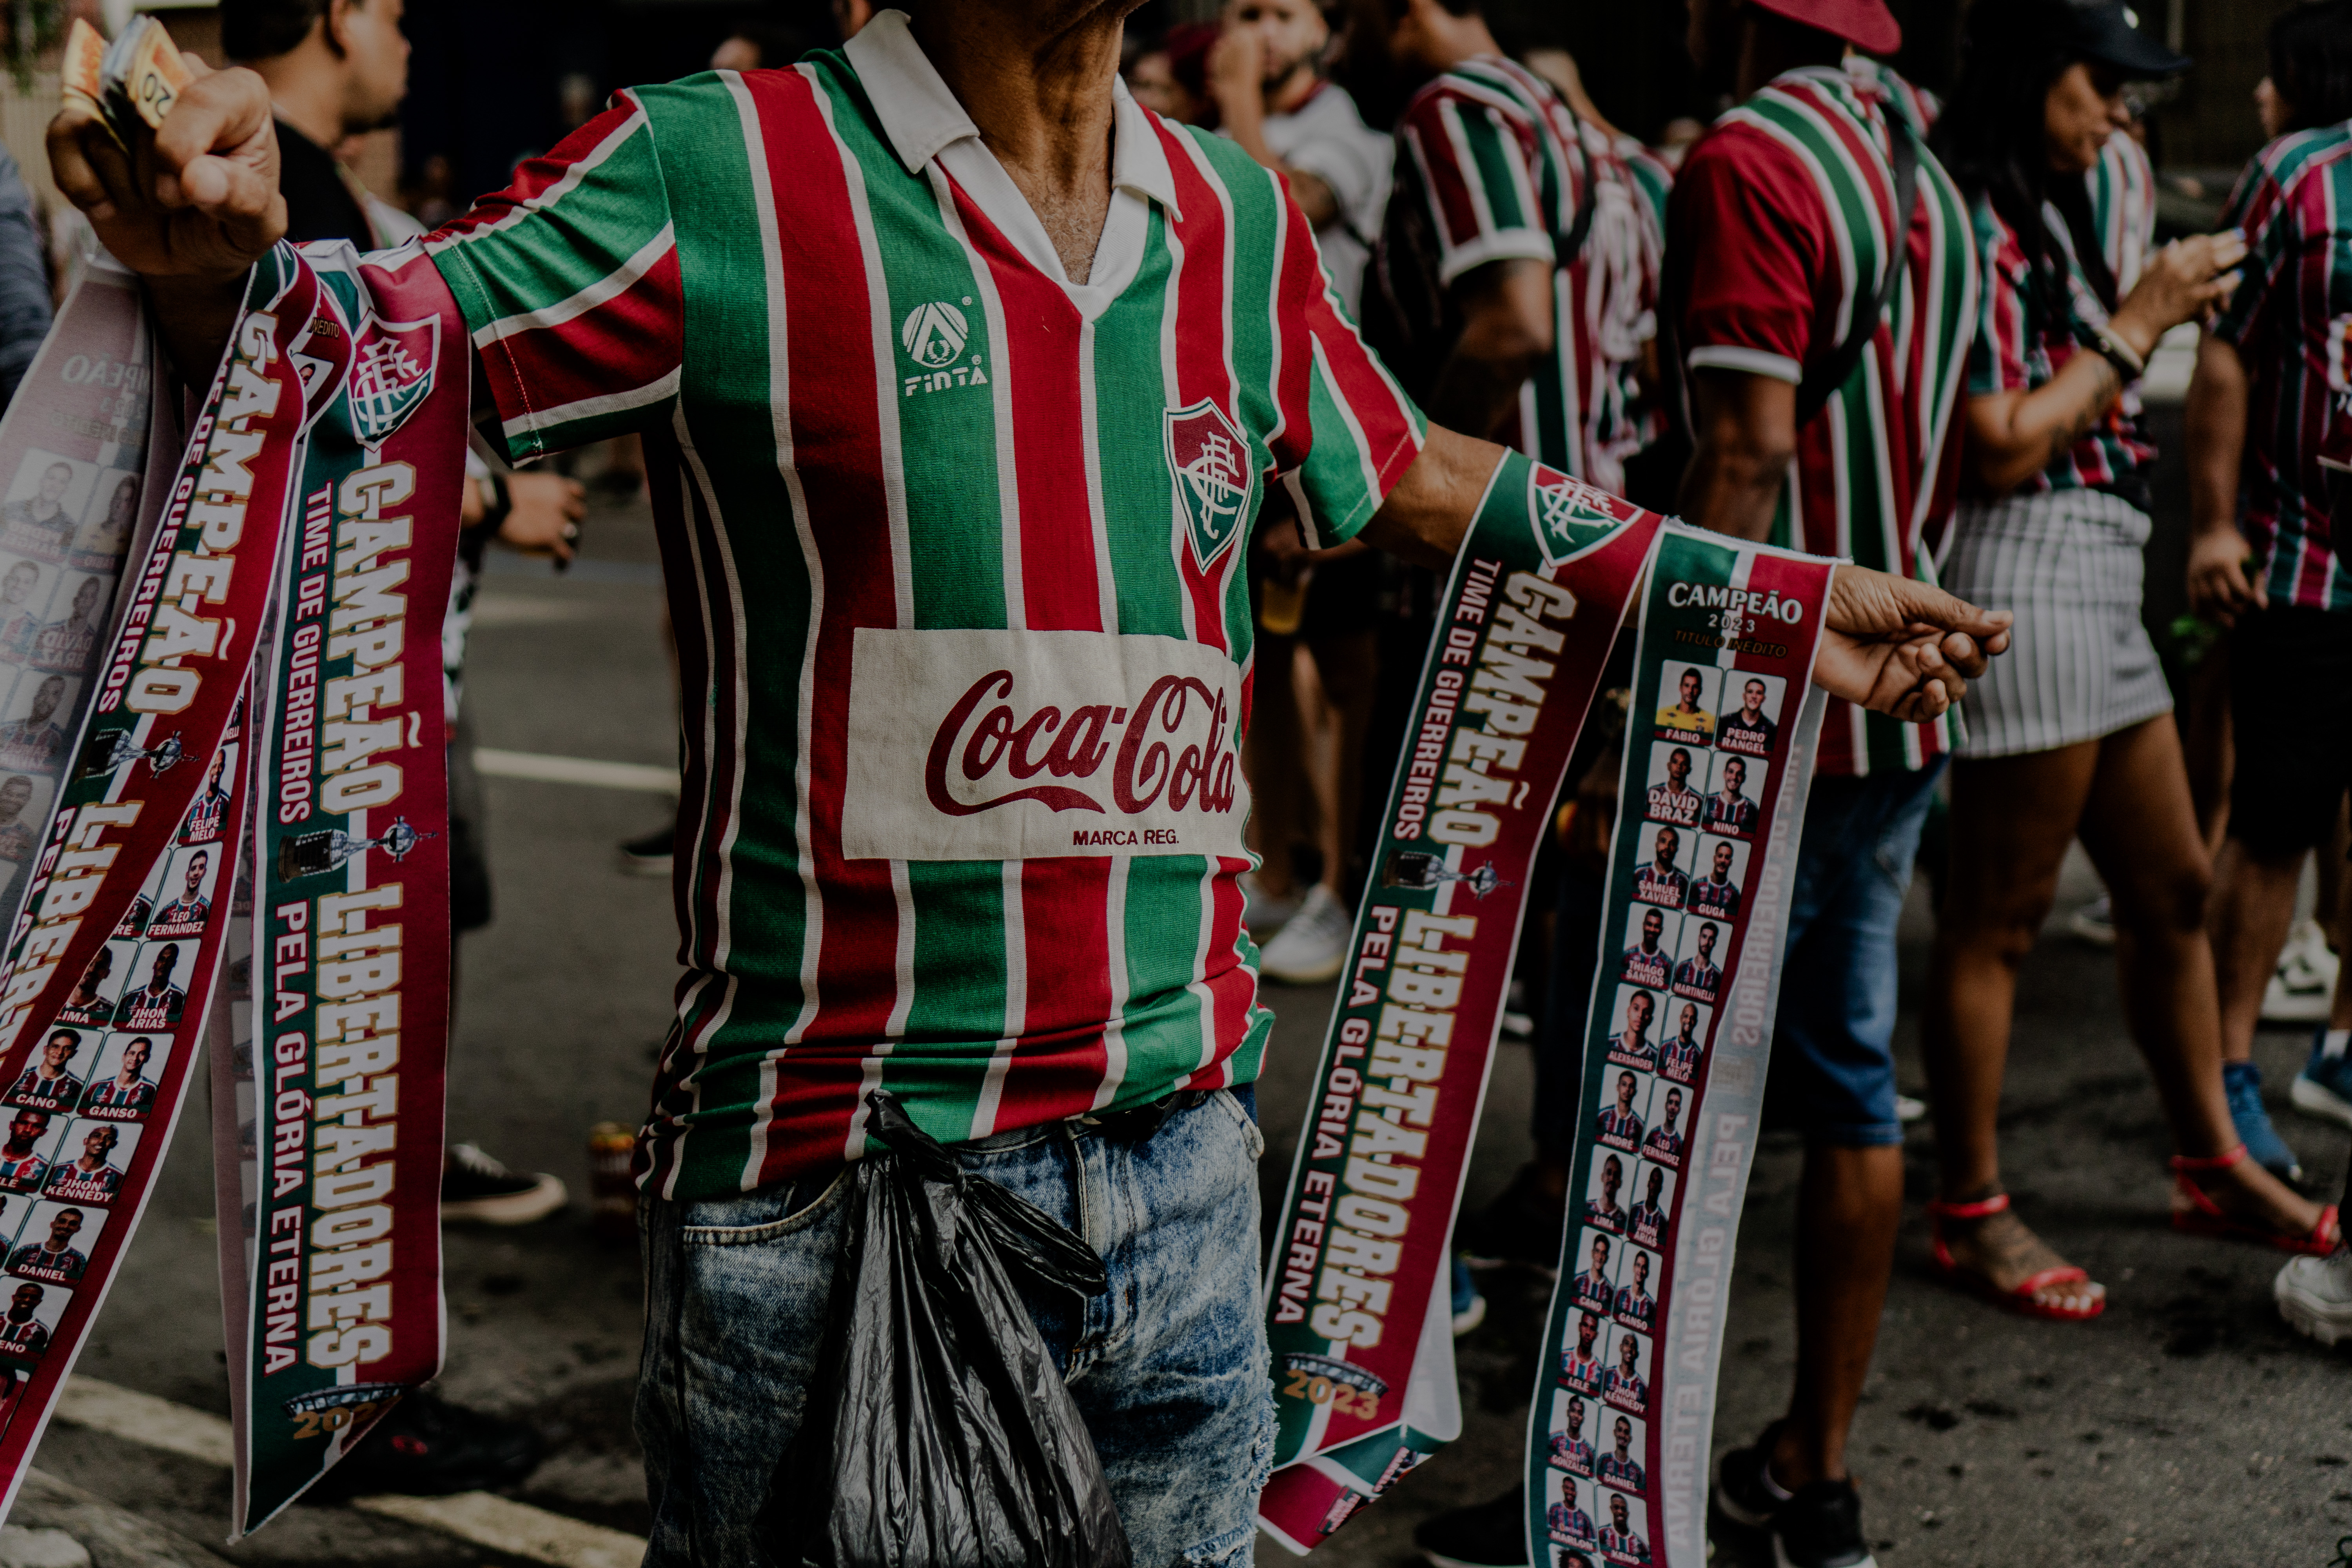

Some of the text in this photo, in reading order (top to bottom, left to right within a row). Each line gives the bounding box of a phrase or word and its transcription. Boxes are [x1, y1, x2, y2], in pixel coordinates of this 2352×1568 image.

[125, 309, 282, 714] CAMPEÃO
[98, 474, 195, 715] GUERREIROS
[1667, 581, 1803, 625] CAMPEÃO
[1708, 613, 1755, 633] 2023
[319, 460, 423, 815] CAMPEÃO
[1674, 628, 1788, 659] TÍTULO INÉDITO
[277, 478, 333, 825] TIME DE GUERREIROS
[1393, 556, 1503, 841] TIME DE GUERREIROS
[1426, 570, 1579, 848] CAMPEÃO
[926, 670, 1235, 816] Coca-Cola
[1726, 728, 1766, 742] PEDRO
[1721, 737, 1765, 754] RANGEL
[1648, 789, 1699, 811] DAVID
[189, 815, 220, 831] FELIPE
[1649, 803, 1695, 825] BRAZ
[189, 828, 215, 842] MELO
[1713, 821, 1739, 835] NINO
[1073, 829, 1180, 846] MARCA REG.
[1638, 880, 1681, 899] SAMUEL
[1639, 889, 1678, 906] XAVIER
[172, 911, 191, 923] LEO
[1698, 903, 1725, 918] GUGA
[1626, 969, 1665, 987] SANTOS
[1629, 960, 1664, 978] THIAGO
[1674, 982, 1716, 1002] MARTINELLI
[132, 1008, 166, 1019] JHON
[126, 1018, 166, 1029] ARIAS
[1666, 1056, 1694, 1073] FELIPE
[1666, 1065, 1690, 1082] MELO
[16, 1094, 58, 1109] CANO
[89, 1105, 137, 1118] GANSO
[1274, 904, 1401, 1325] PELA GLÓRIA ETERNA
[305, 882, 403, 1369] LIBERTADORES
[1309, 908, 1479, 1350] LIBERTADORES
[263, 898, 314, 1377] PELA GLÓRIA ETERNA
[1657, 1139, 1671, 1151] LEO
[0, 1177, 19, 1189] LÉ
[64, 1178, 102, 1191] JHON
[45, 1185, 115, 1202] KENNEDY
[1593, 1214, 1615, 1230] LIMA
[1633, 1230, 1658, 1249] ARIAS
[18, 1263, 66, 1281] DANIEL
[1579, 1295, 1602, 1311] CANO
[1619, 1312, 1648, 1331] GANSO
[0, 1339, 26, 1353] ENO
[1283, 1369, 1380, 1422] 2023
[1605, 1390, 1646, 1414] KENNEDY
[293, 1394, 404, 1440] 202
[1604, 1473, 1637, 1491] DANIEL
[1611, 1549, 1640, 1565] KENO
